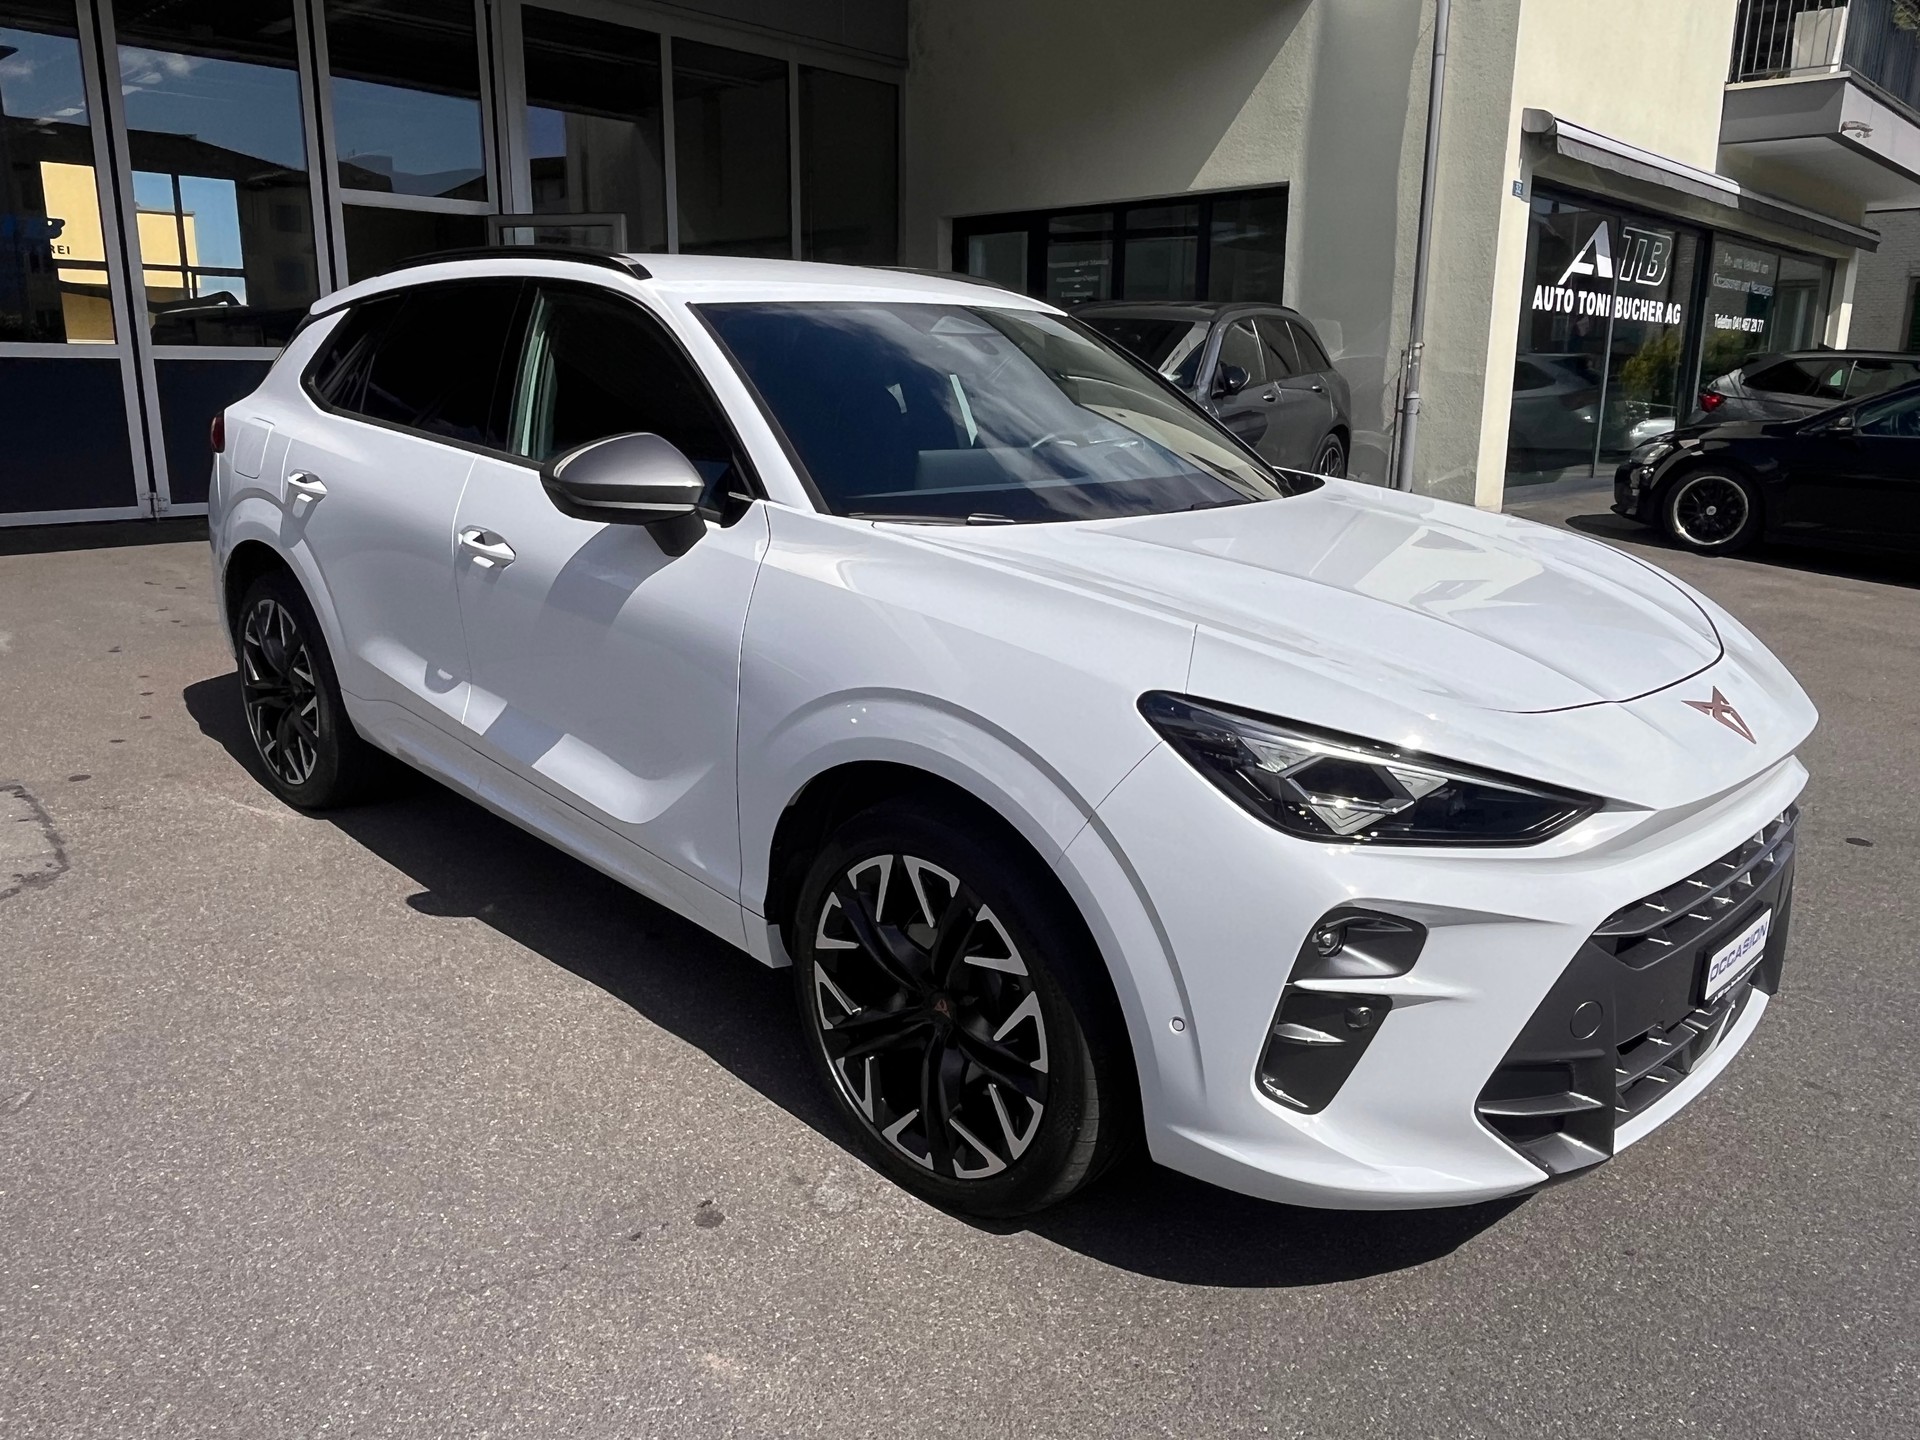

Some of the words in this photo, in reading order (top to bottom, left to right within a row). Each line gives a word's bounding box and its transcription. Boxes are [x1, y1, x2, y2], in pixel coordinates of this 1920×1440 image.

[1532, 284, 1574, 313] AUTO
[1578, 290, 1611, 317] TONI
[1614, 296, 1663, 323] BUCHER
[1664, 302, 1682, 325] AG
[1710, 921, 1768, 983] OCCASION
